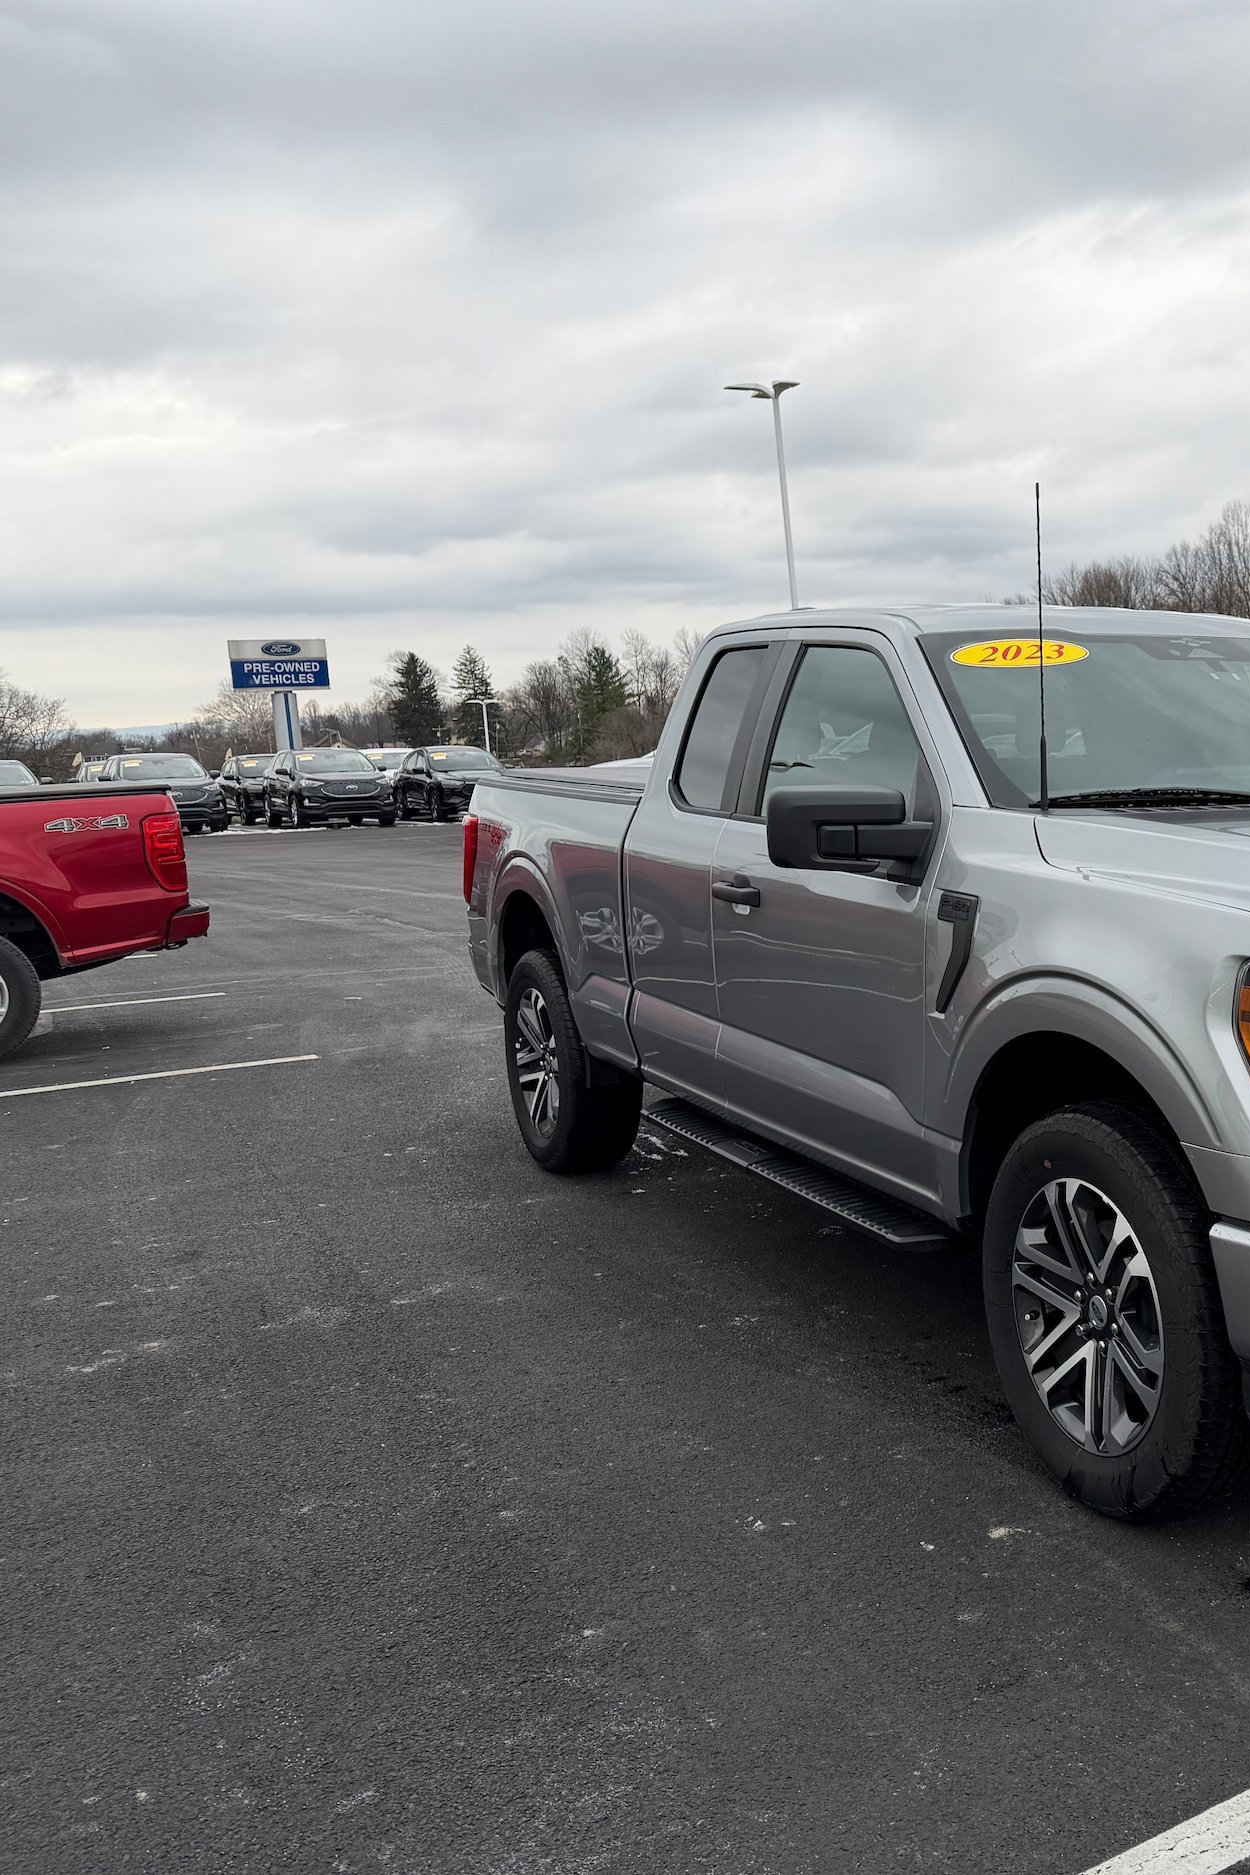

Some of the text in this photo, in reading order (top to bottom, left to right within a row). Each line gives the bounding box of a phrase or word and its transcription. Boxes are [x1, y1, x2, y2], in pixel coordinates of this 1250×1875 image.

[979, 644, 1065, 663] 2023
[244, 662, 320, 673] PRE-OWNED
[252, 673, 315, 685] VEHICLES
